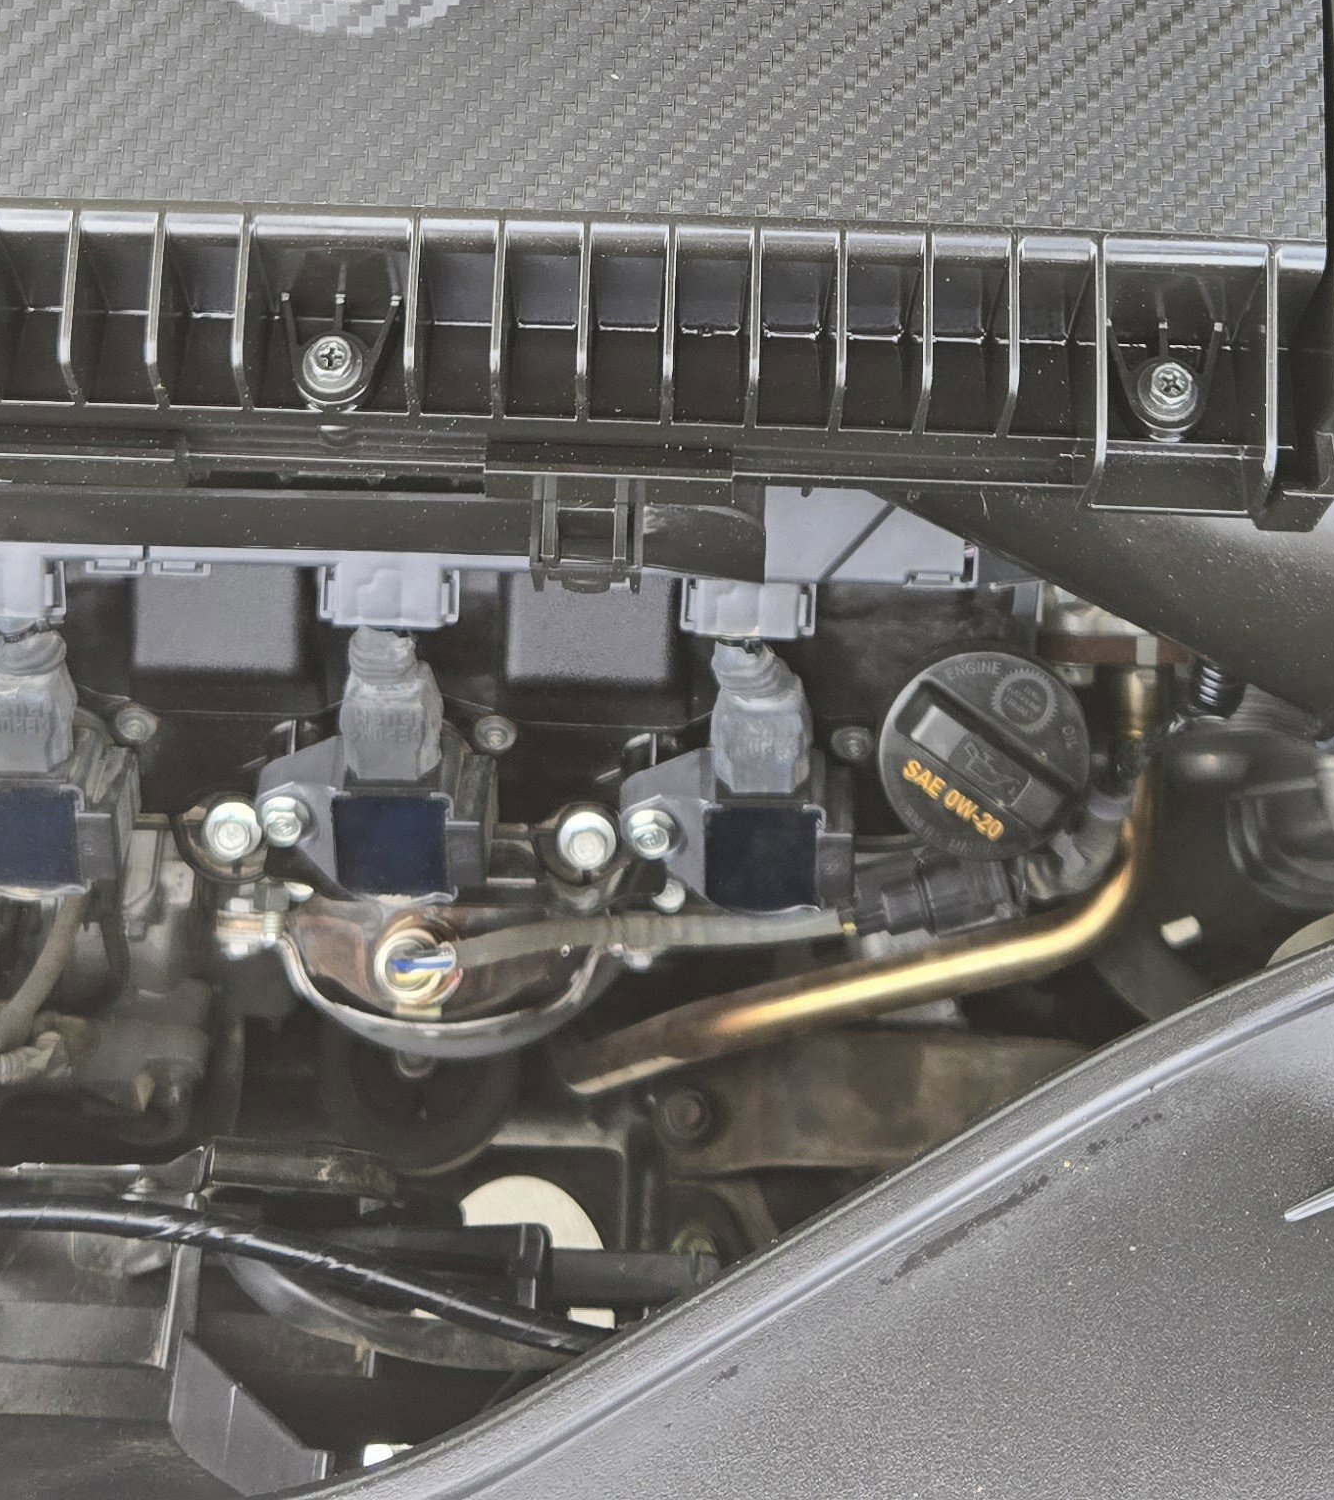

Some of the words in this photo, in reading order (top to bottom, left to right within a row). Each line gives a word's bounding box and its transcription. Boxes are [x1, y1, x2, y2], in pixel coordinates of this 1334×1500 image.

[945, 661, 1002, 682] ENGINE
[902, 759, 947, 801] SAE
[943, 788, 1005, 842] 0W-20
